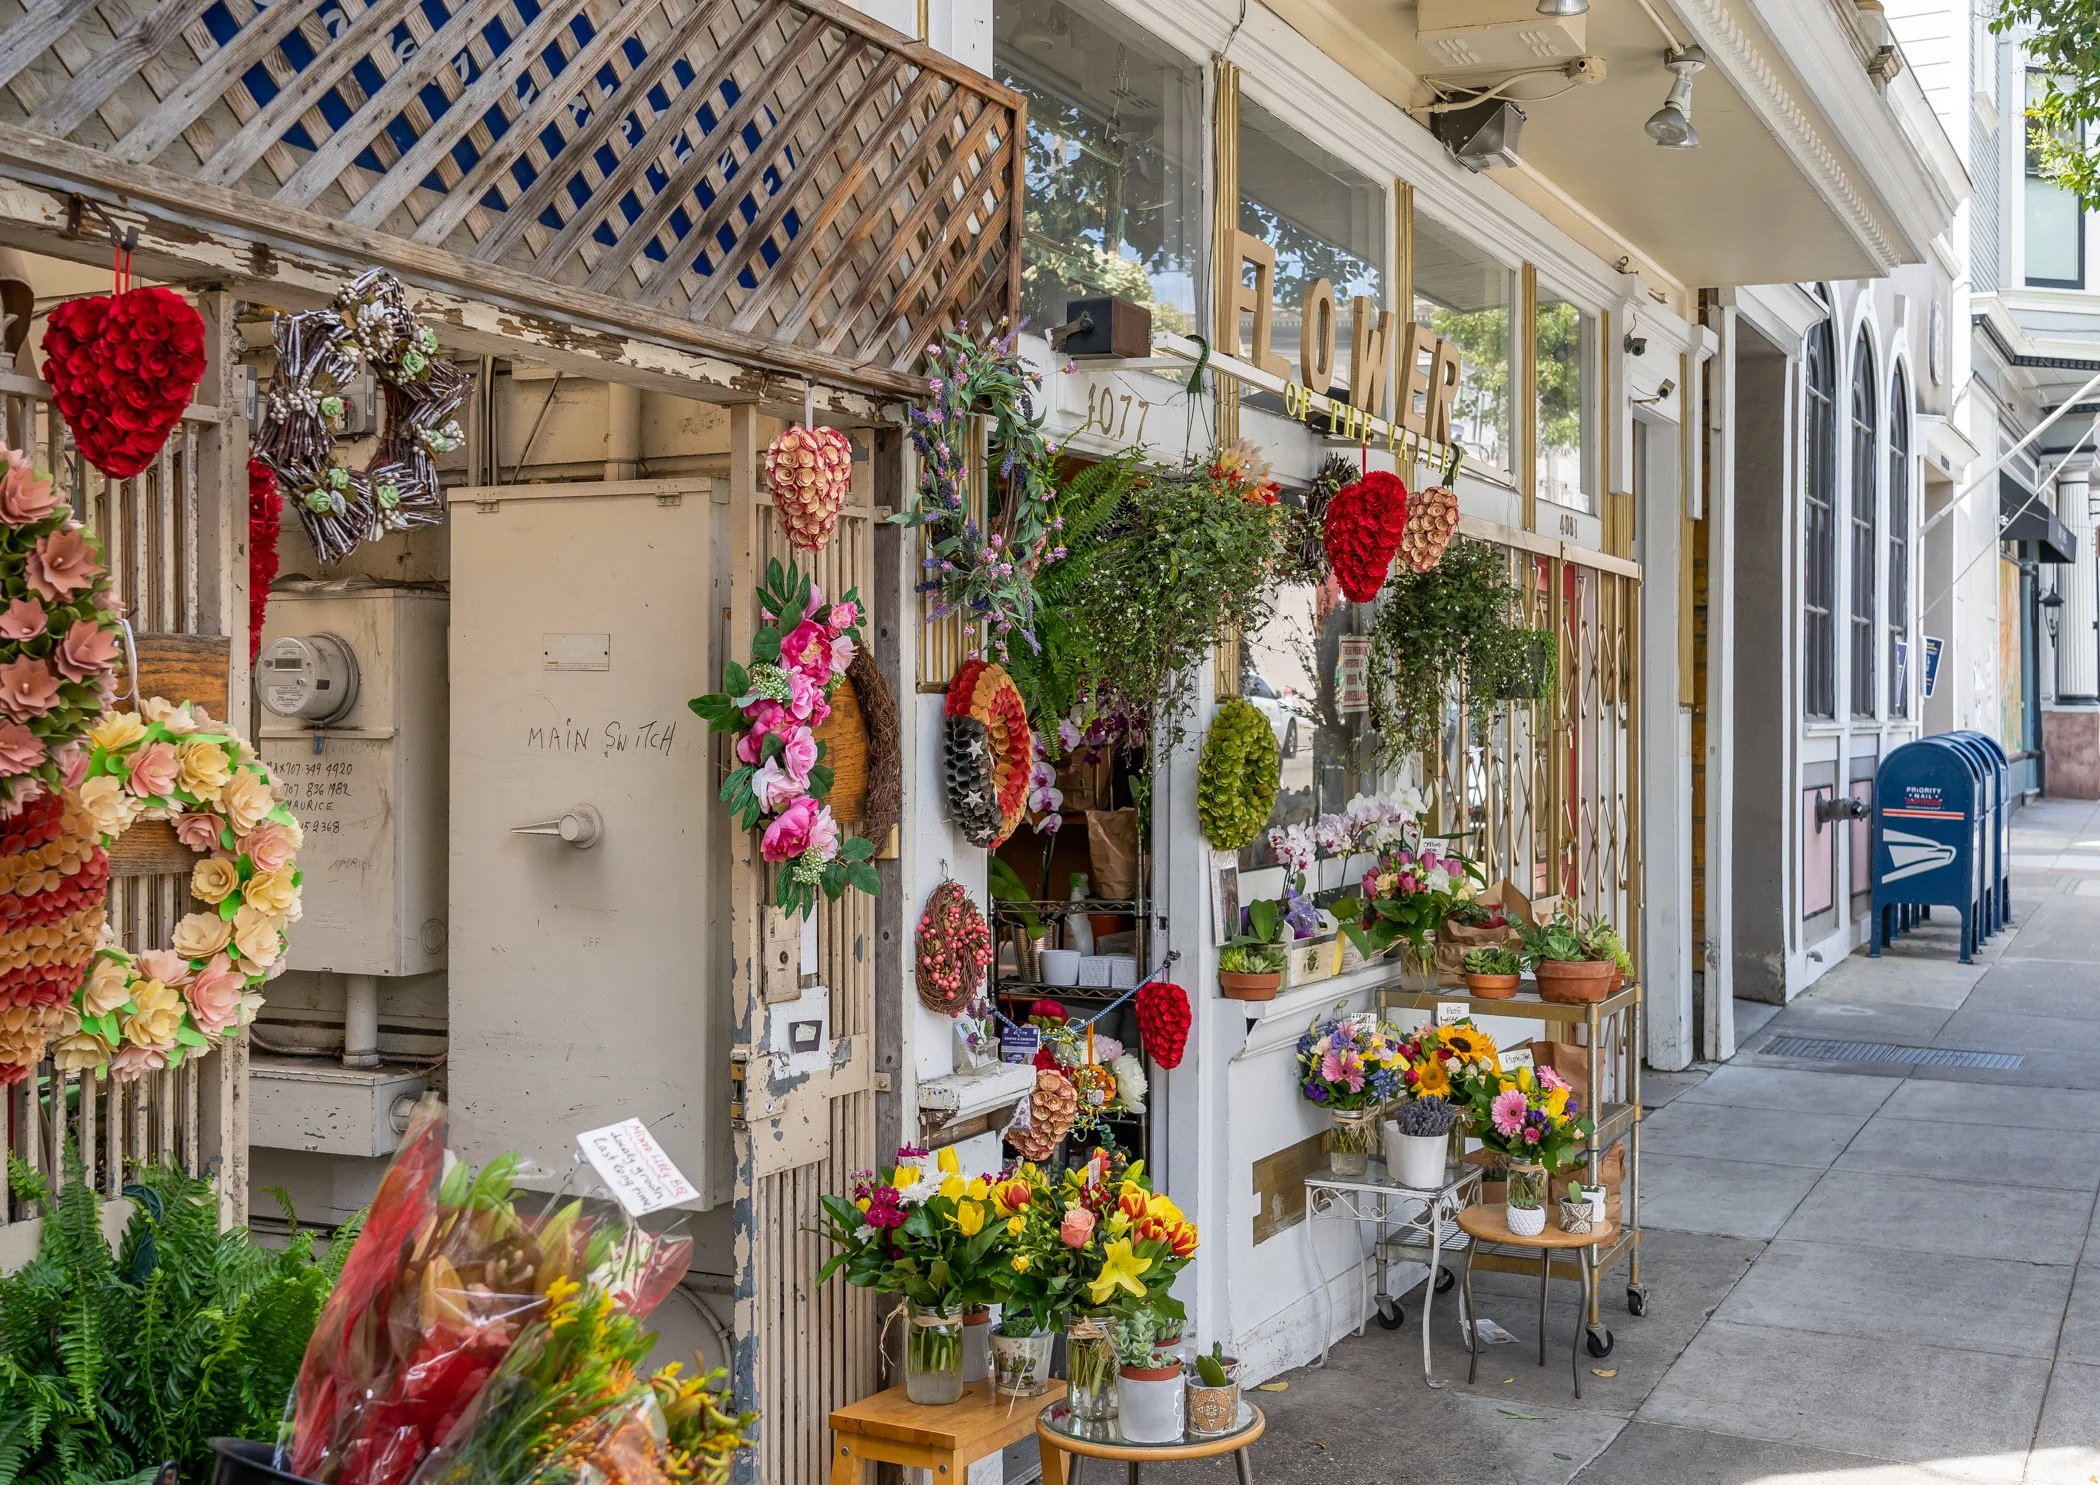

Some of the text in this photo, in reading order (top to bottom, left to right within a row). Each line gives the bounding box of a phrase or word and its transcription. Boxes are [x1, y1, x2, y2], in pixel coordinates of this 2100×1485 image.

[1220, 228, 1462, 446] FLOWER
[1284, 380, 1467, 480] OF THE VALLEY
[1559, 514, 1577, 539] 4081
[528, 718, 590, 752] MAIN
[284, 783, 299, 795] 707
[306, 782, 324, 797] 836
[1906, 786, 1942, 794] PRIORITY
[286, 799, 334, 811] MAURICE
[581, 936, 601, 948] OFF
